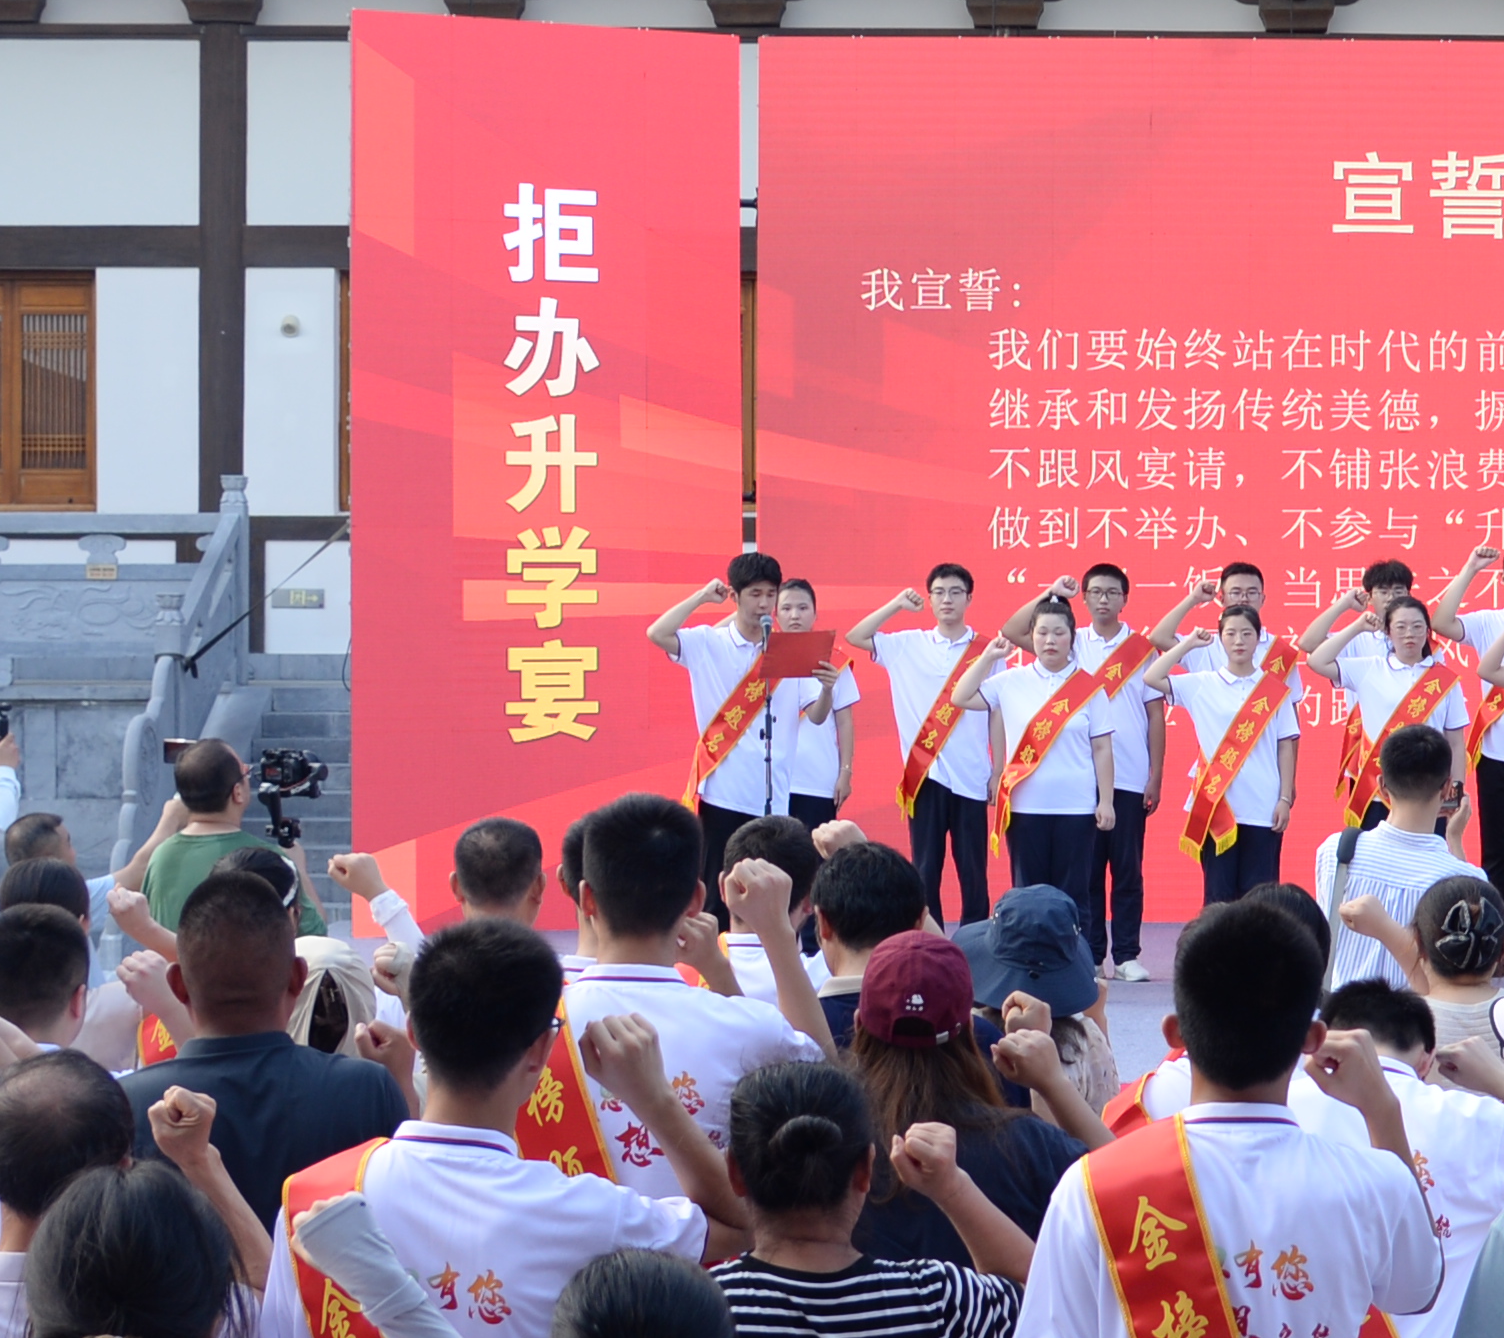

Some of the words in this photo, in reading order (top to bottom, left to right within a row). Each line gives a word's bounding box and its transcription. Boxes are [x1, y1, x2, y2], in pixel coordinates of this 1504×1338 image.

[502, 182, 600, 744] 拒办升学宴
[1203, 695, 1271, 795] 金榜题名
